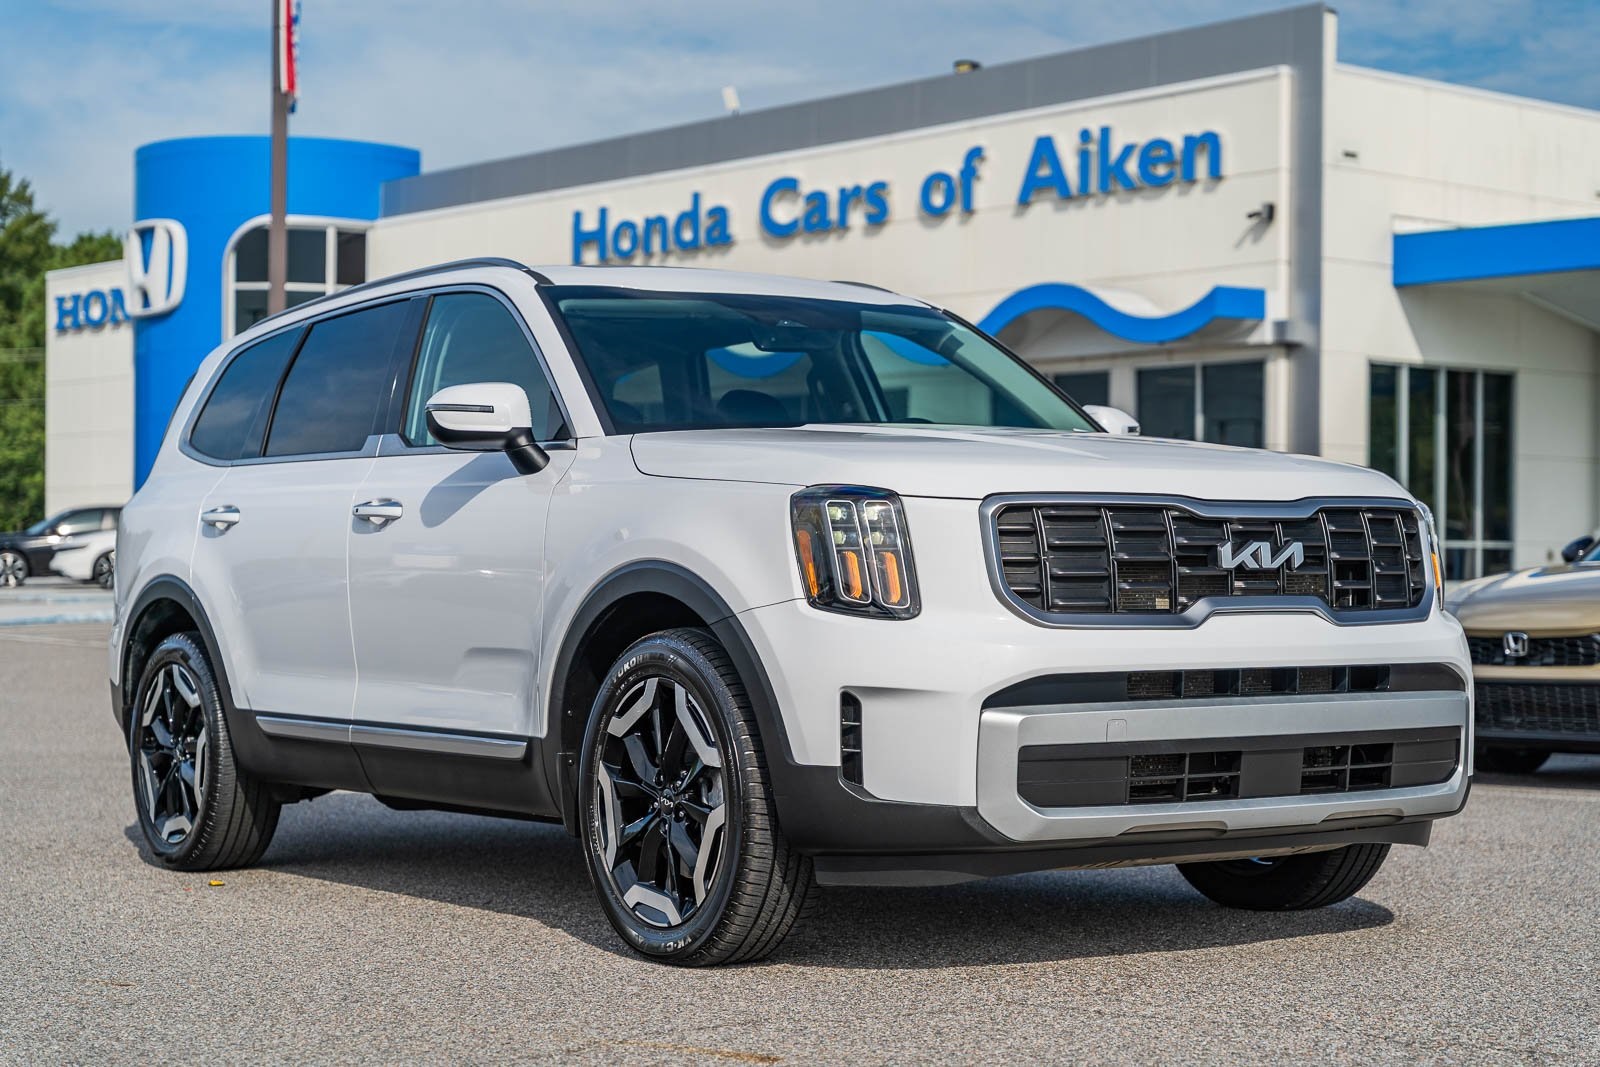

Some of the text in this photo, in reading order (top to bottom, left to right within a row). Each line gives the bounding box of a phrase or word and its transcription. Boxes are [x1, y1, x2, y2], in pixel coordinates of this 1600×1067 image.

[572, 126, 1222, 265] Honda Cars of Aiken
[1217, 541, 1304, 569] KIA
